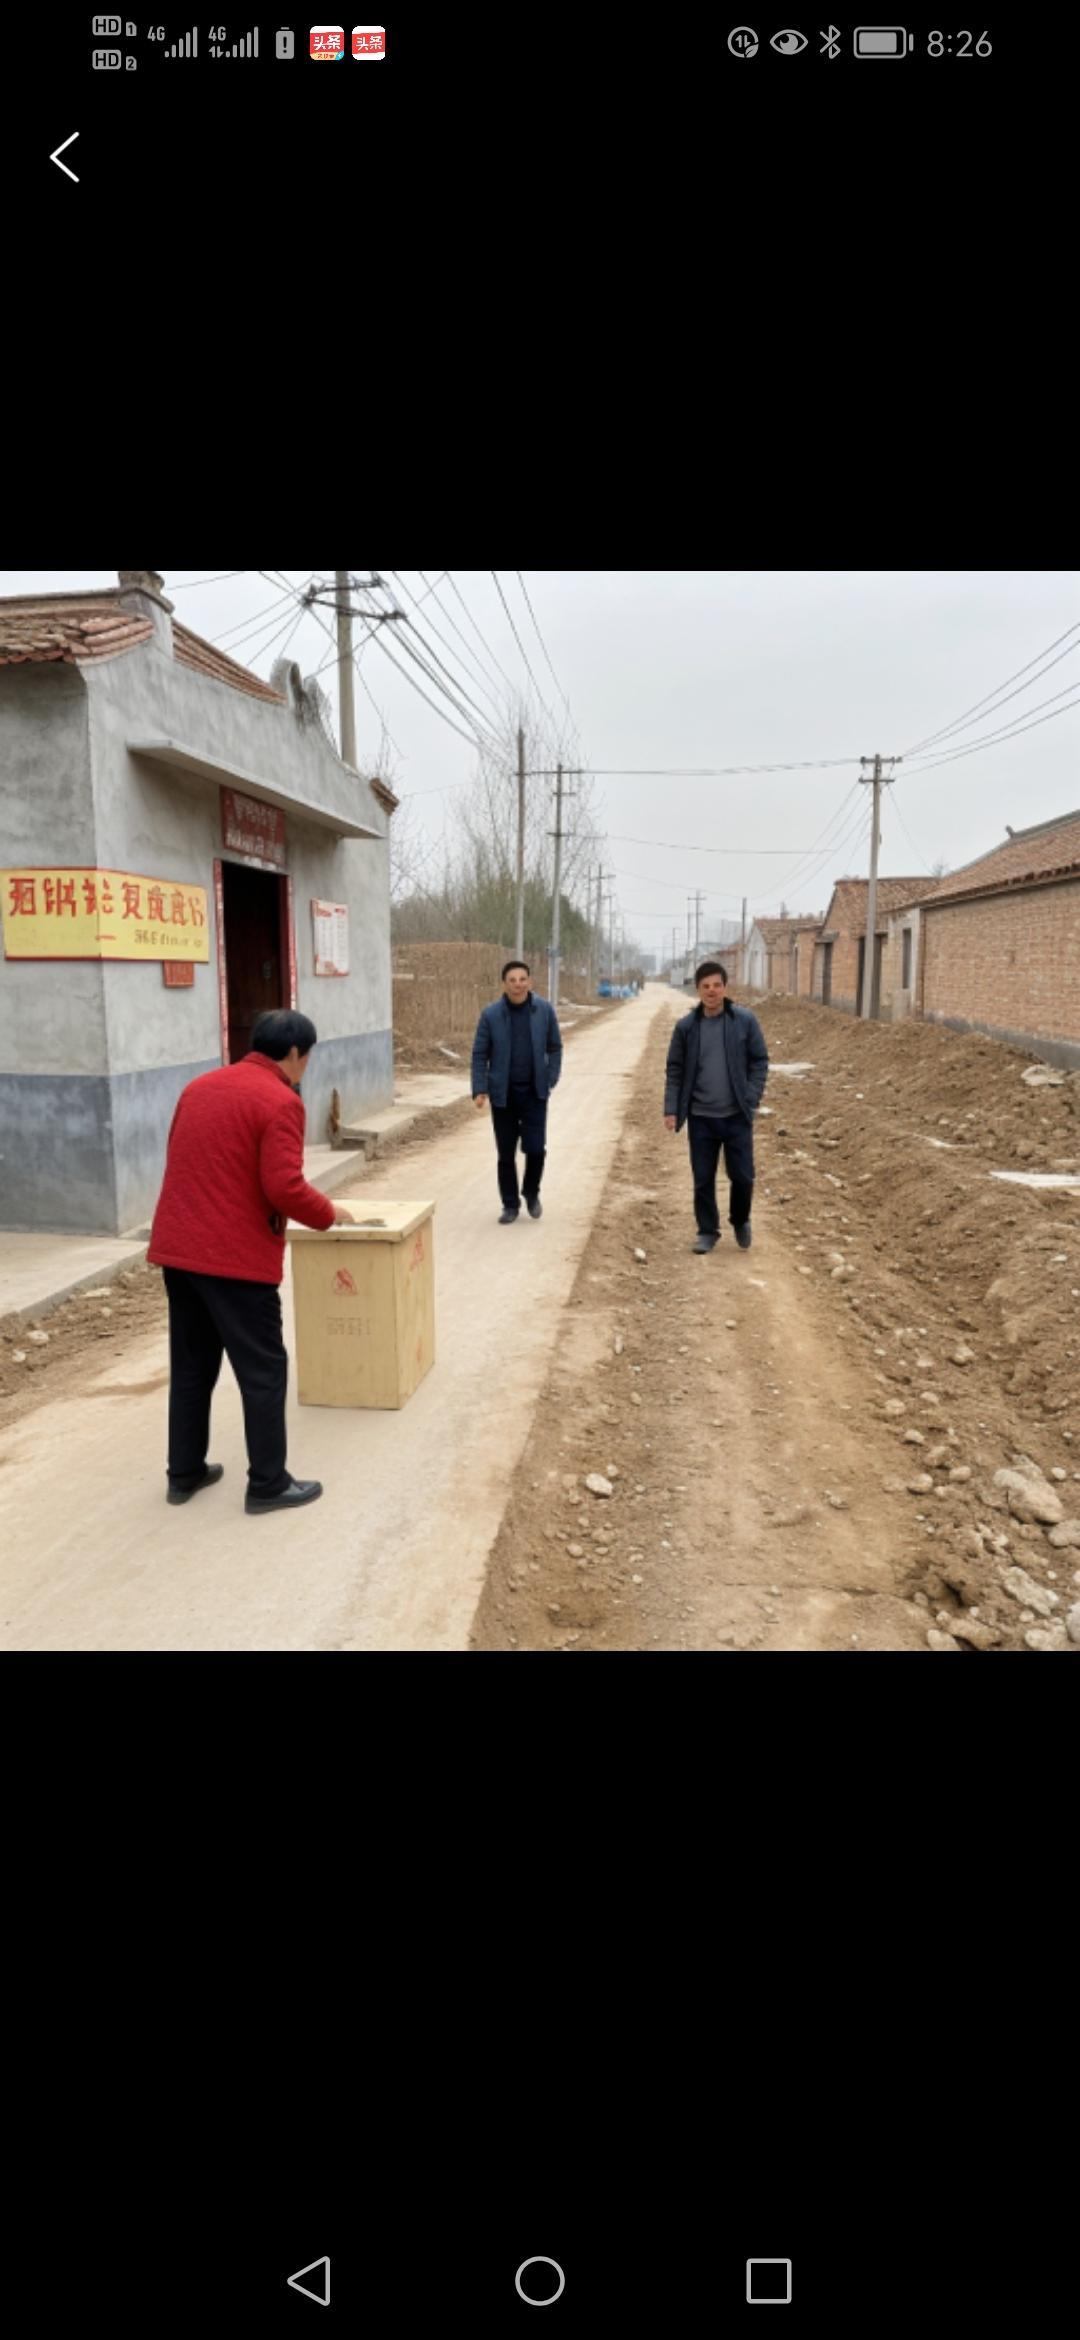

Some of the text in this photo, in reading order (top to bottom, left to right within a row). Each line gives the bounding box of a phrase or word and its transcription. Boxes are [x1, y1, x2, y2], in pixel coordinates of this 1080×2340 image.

[95, 18, 119, 33] HD
[147, 26, 166, 41] 4G
[208, 26, 226, 41] 4G
[313, 34, 341, 51] 头条
[356, 36, 382, 51] 头条
[927, 30, 993, 57] 8:26
[95, 52, 119, 67] HD
